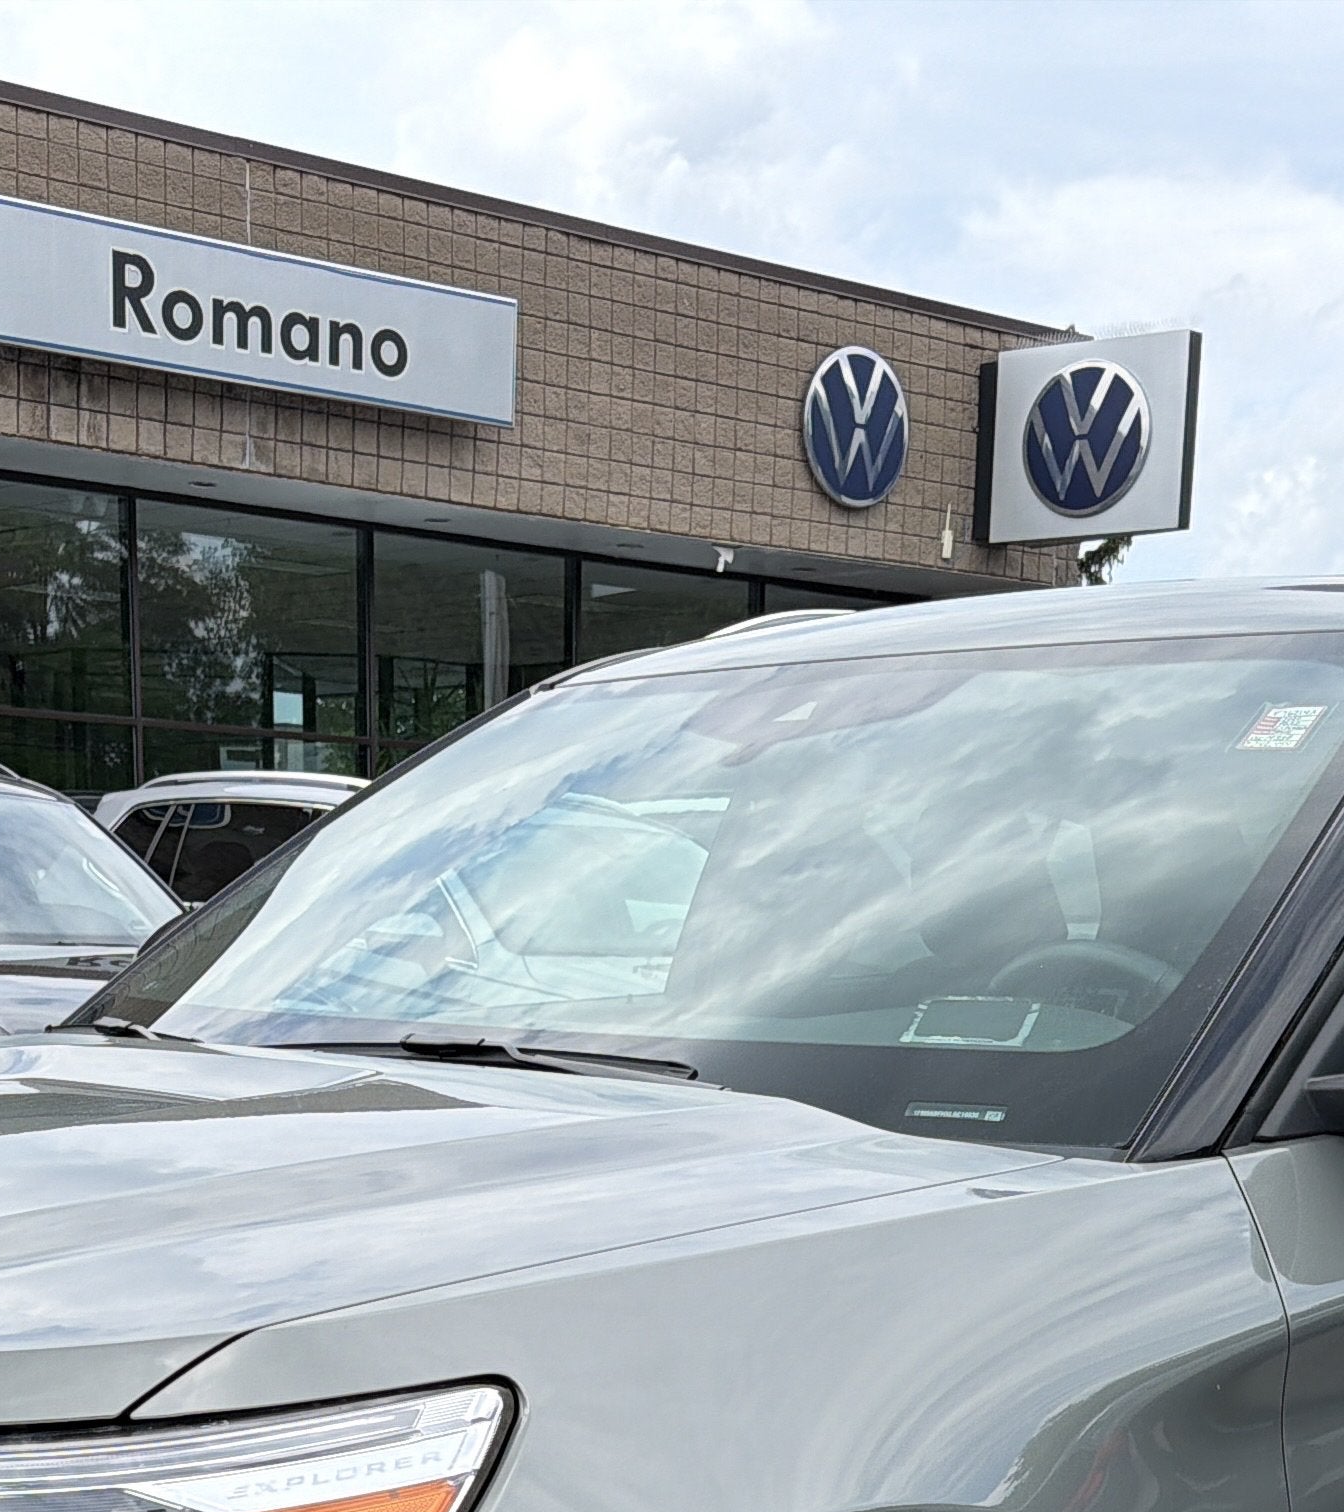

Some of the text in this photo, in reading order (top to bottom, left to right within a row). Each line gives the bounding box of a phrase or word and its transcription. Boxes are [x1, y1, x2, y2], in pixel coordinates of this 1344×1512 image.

[111, 248, 409, 378] Romano
[808, 350, 906, 496] VW
[1029, 362, 1145, 503] VW
[227, 1451, 443, 1500] EXPLORER
